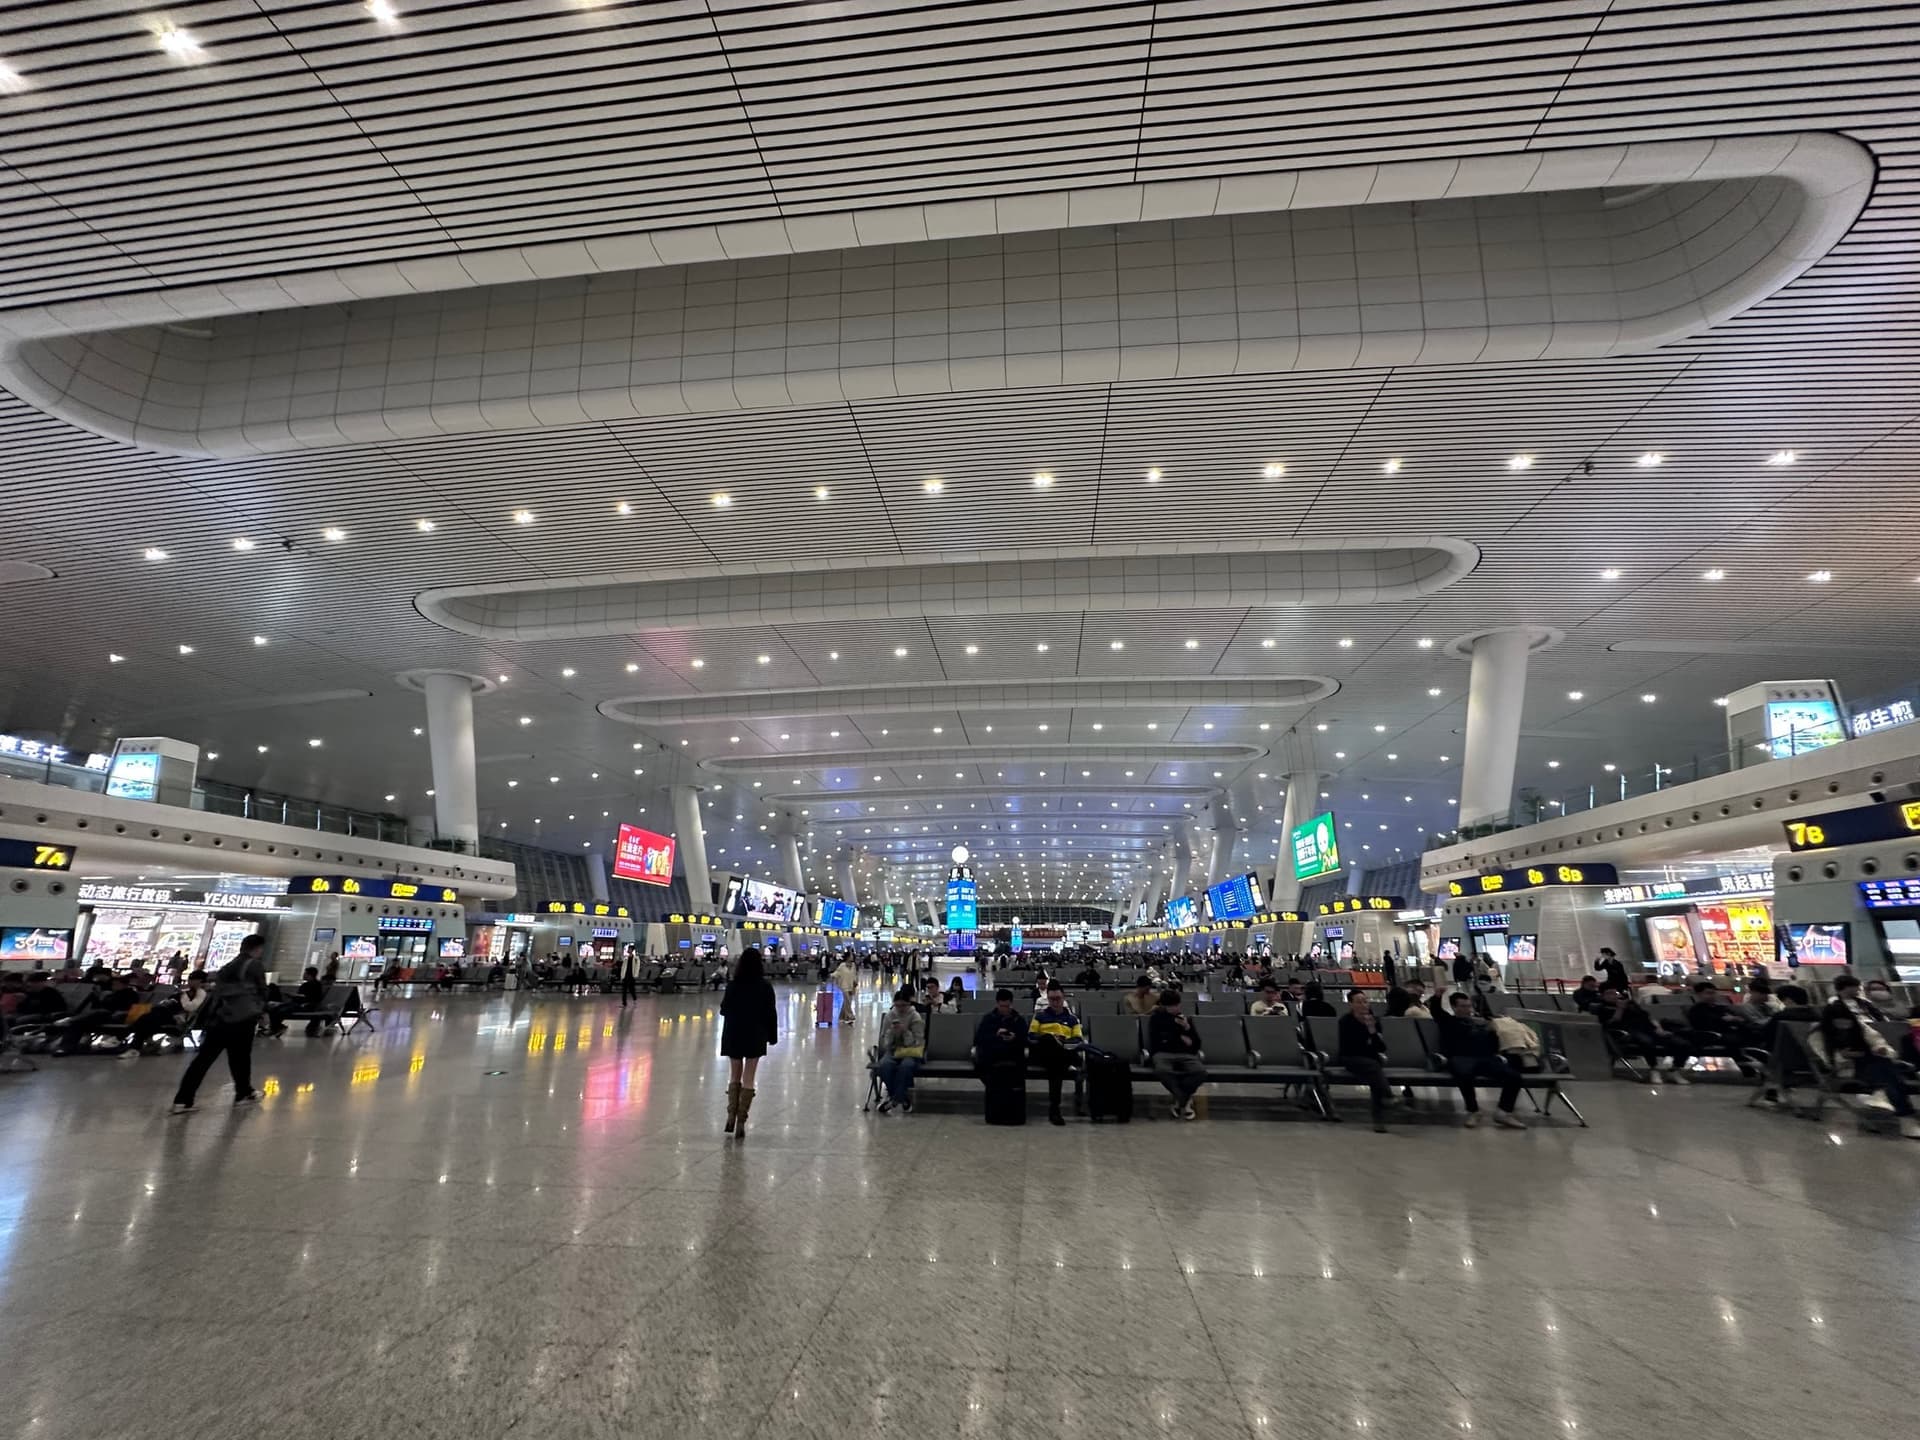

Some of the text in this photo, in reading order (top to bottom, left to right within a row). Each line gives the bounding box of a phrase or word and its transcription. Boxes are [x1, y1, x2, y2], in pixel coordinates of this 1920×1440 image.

[1791, 822, 1825, 846] 7B
[34, 846, 67, 866] 7A
[1528, 869, 1545, 885] 8B
[1558, 866, 1584, 883] 8B
[78, 884, 170, 902] 动态旅行数码
[311, 878, 329, 892] 8A
[343, 879, 360, 893] 8A
[549, 902, 565, 913] 10A
[1370, 898, 1392, 909] 10B
